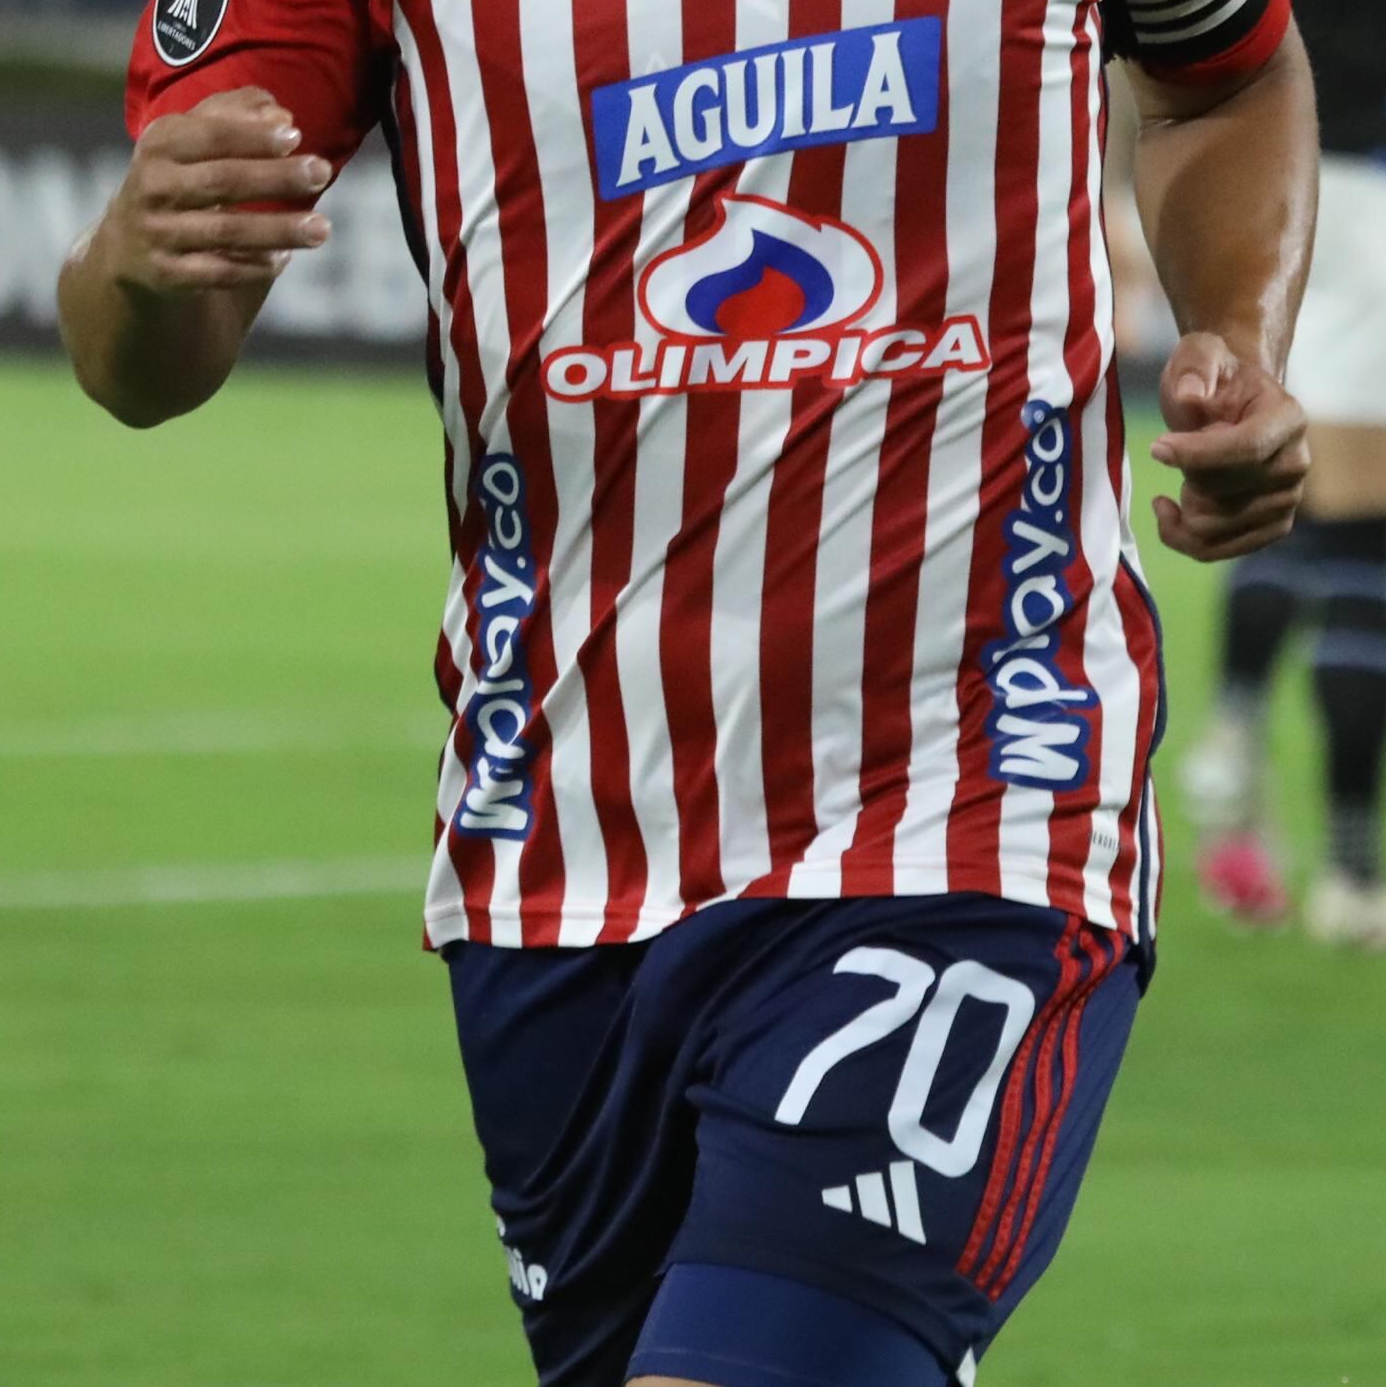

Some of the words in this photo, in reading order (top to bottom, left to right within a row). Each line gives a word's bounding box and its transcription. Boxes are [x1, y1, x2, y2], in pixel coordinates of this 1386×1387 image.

[615, 30, 917, 188] AGUILA
[545, 320, 985, 397] OLIMPICA
[774, 945, 1037, 1178] 70
